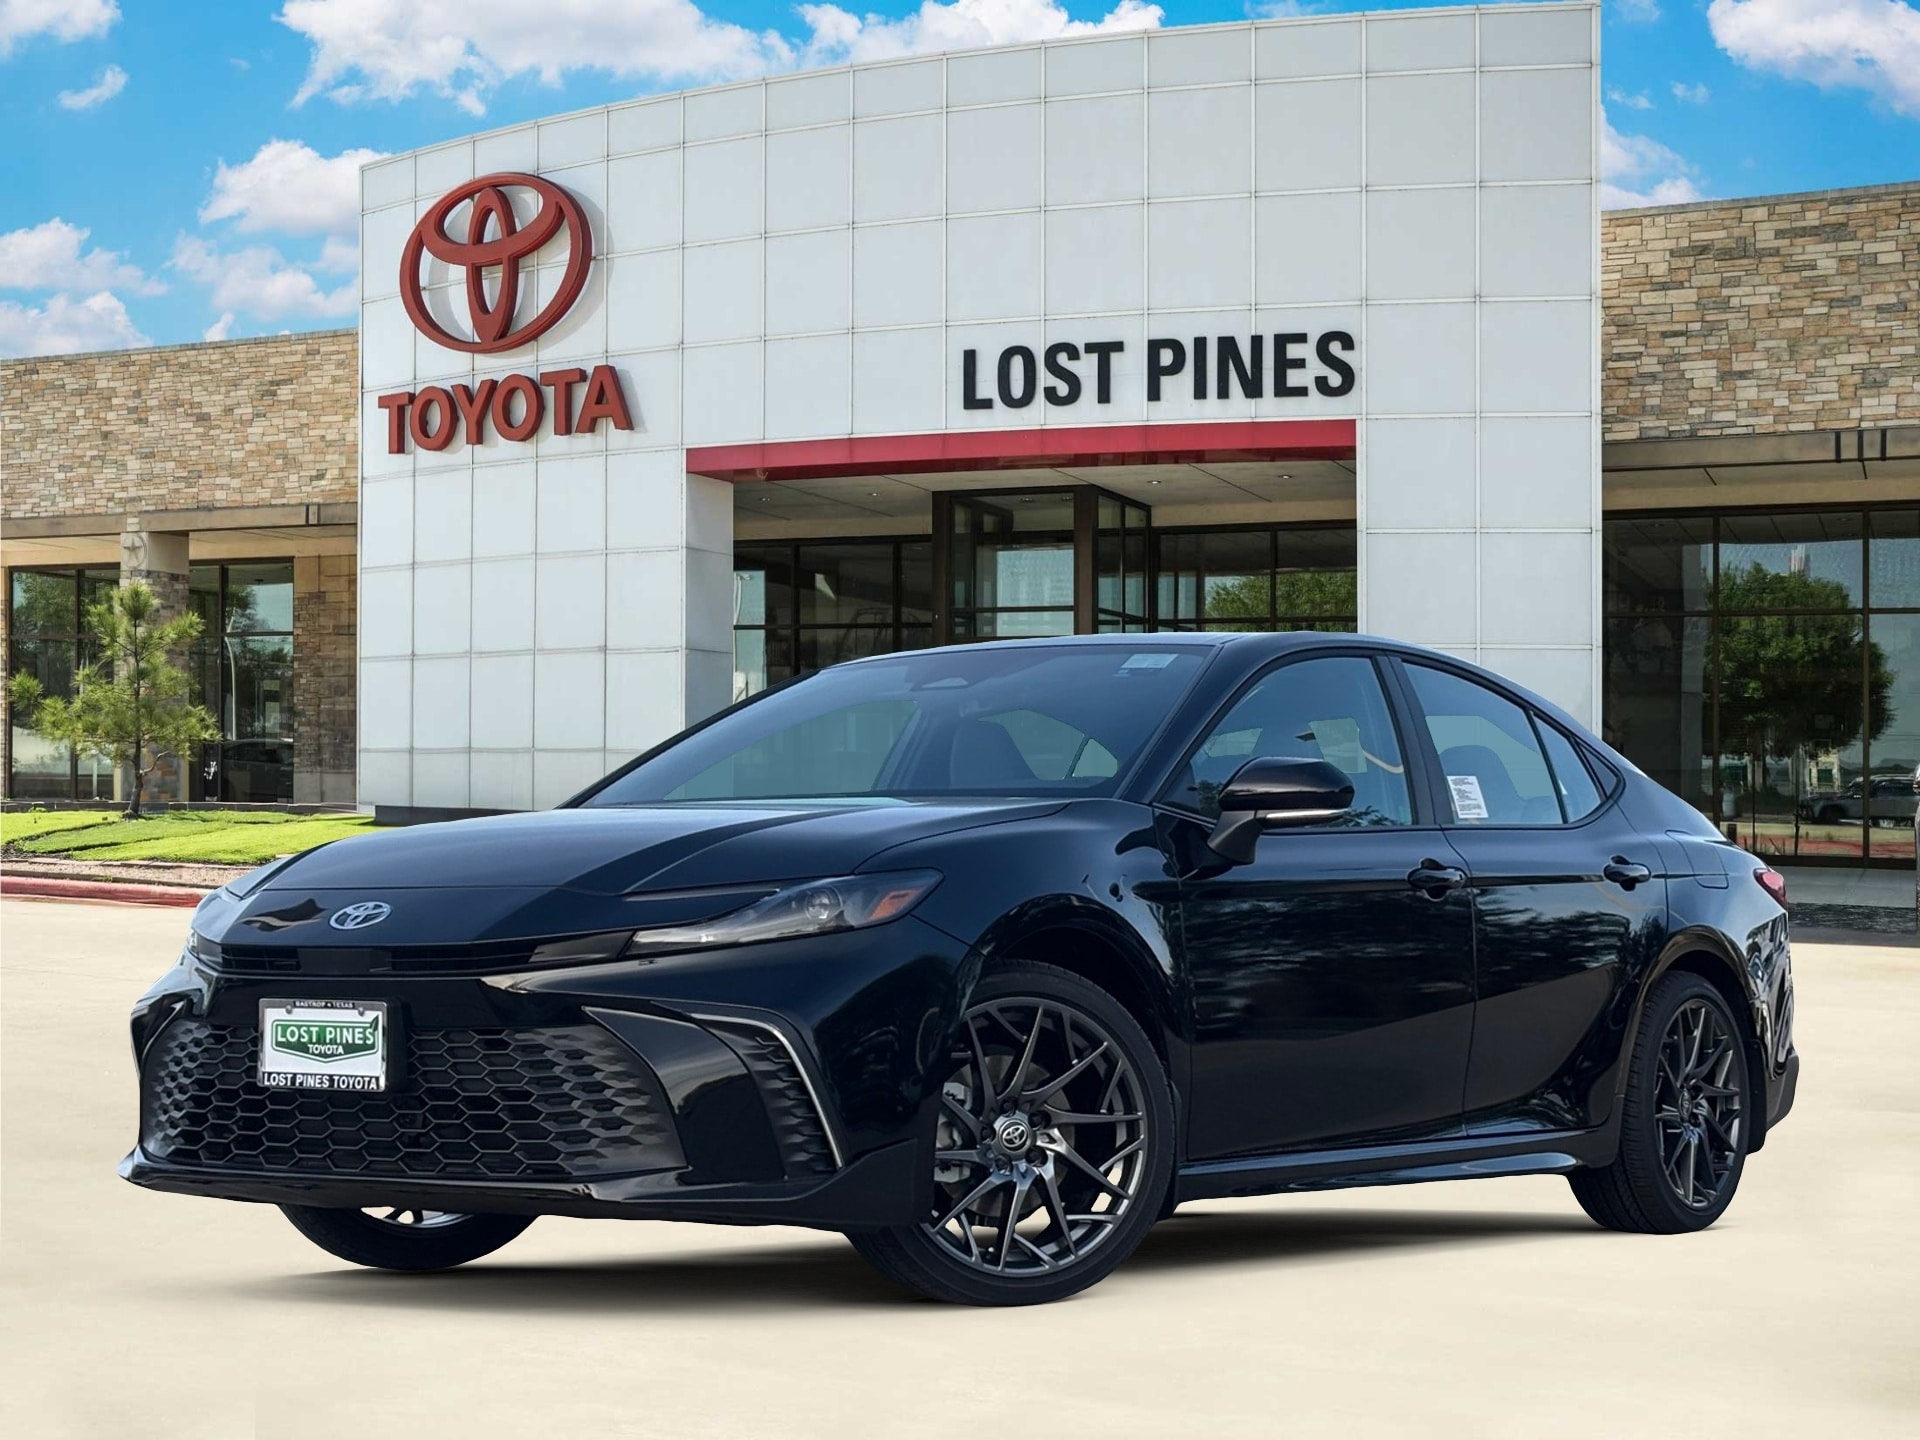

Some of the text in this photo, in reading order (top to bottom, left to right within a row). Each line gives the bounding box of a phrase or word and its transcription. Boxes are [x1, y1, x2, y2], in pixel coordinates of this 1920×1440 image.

[963, 330, 1356, 410] LOST PINES
[378, 364, 634, 455] TOYOTA
[277, 1026, 374, 1044] LOST PINES
[308, 1044, 344, 1055] TOYOTA
[264, 1073, 377, 1090] LOST PINES TOYOTA
